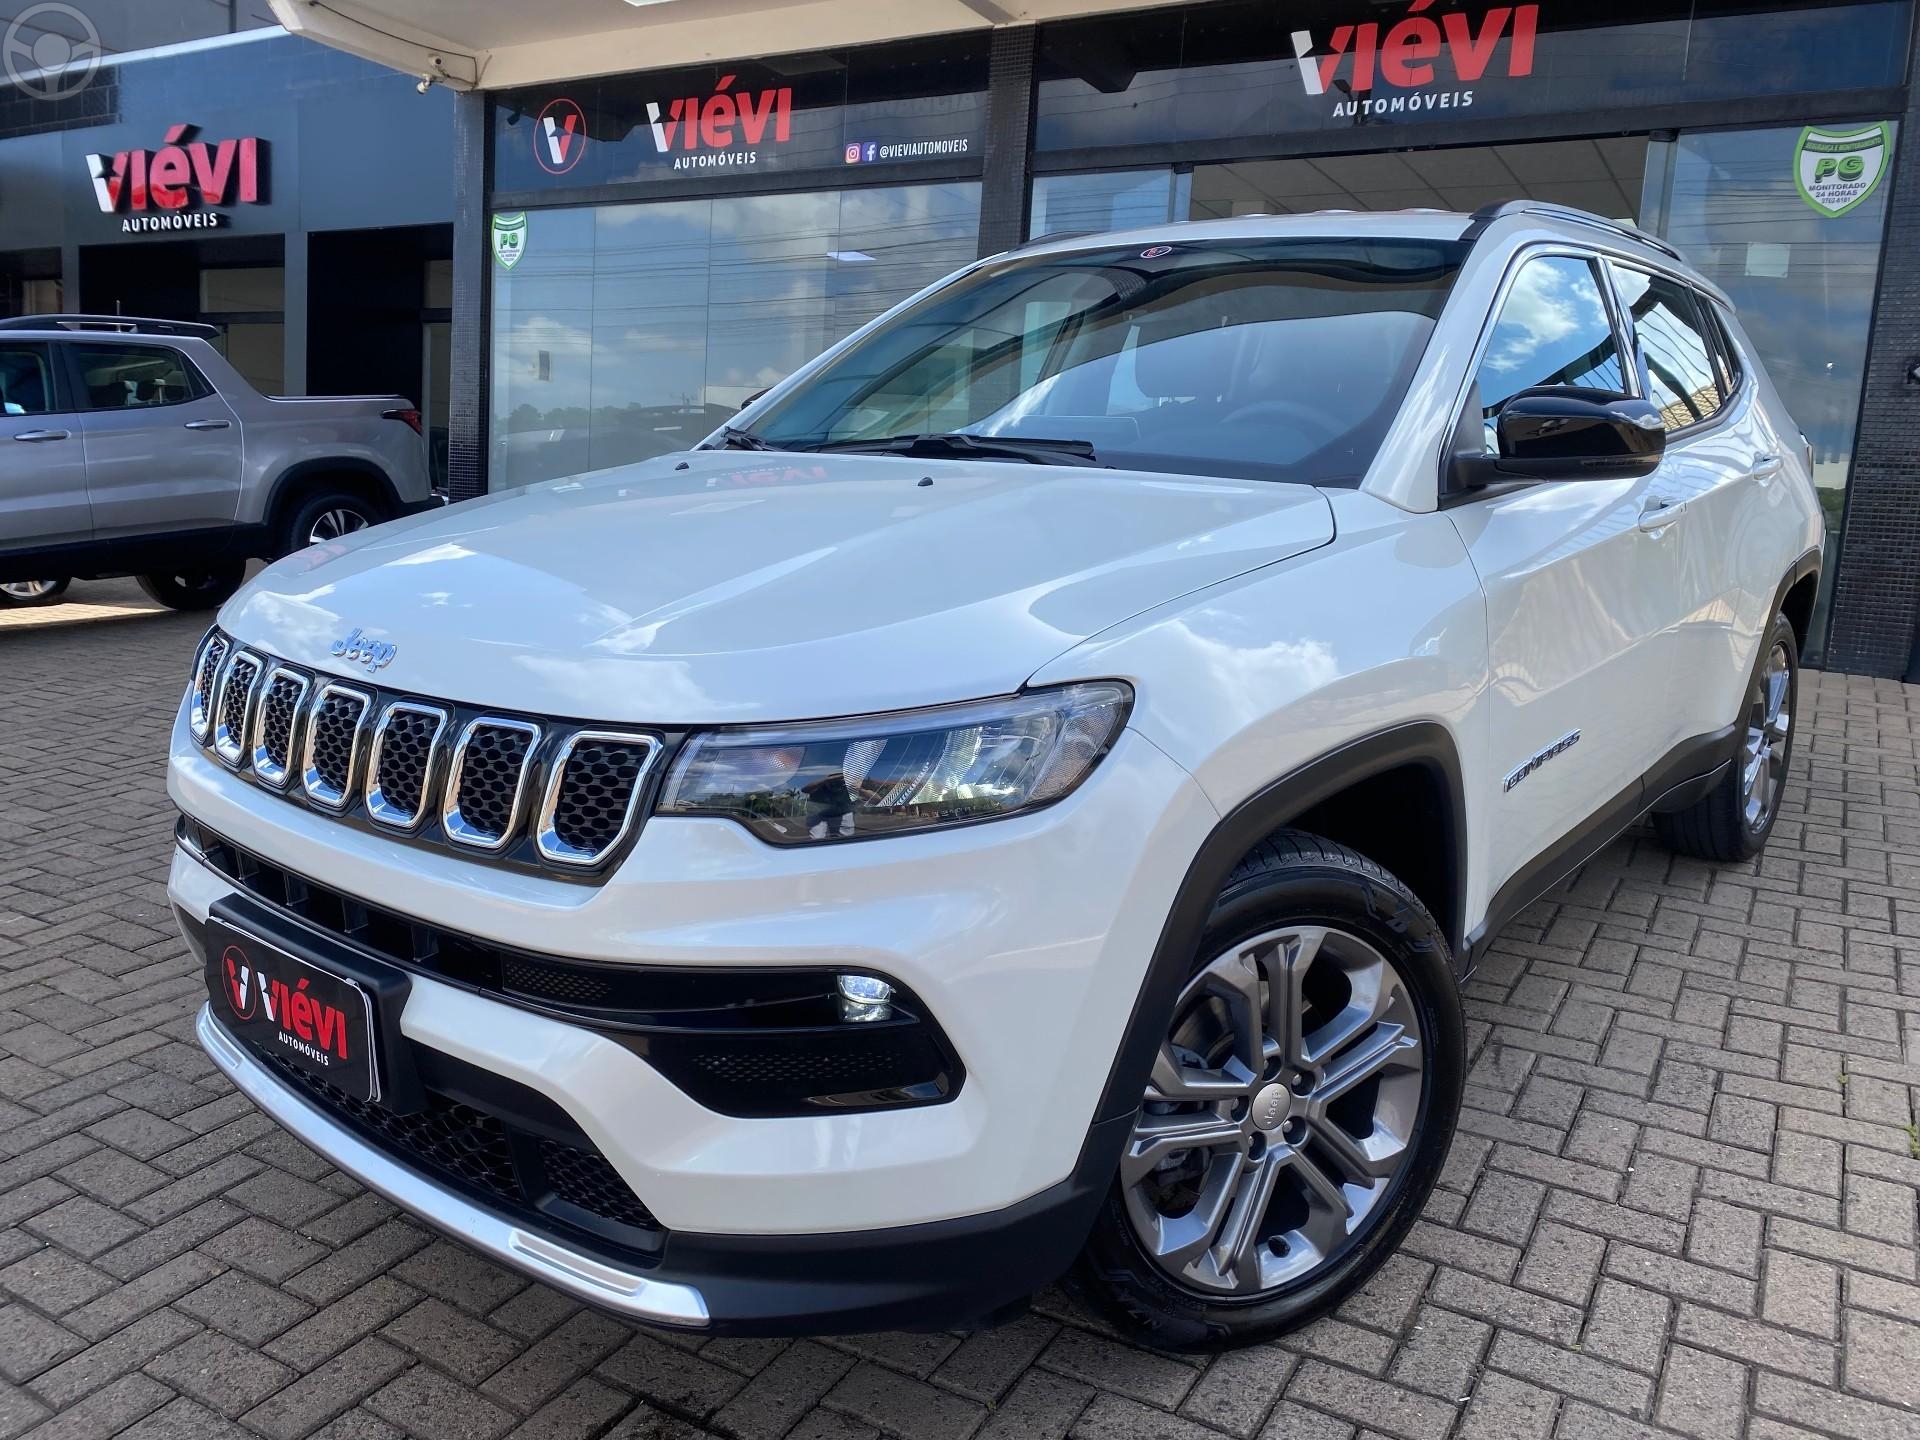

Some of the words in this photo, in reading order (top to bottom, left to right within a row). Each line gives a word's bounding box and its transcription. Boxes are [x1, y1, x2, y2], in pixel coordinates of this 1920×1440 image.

[1333, 91, 1473, 117] AUTOMÓVEIS
[880, 138, 968, 158] @VIEVIAUTOMOVEIS
[674, 151, 757, 170] AUTOMÓVEIS
[1808, 182, 1867, 192] MONITORADO
[1828, 189, 1859, 198] HORAS
[122, 211, 219, 233] AUTOMÓVEIS
[330, 627, 398, 674] Jeep
[1502, 728, 1582, 793] COMPASS
[278, 1031, 330, 1066] AUTOMÓVEIS
